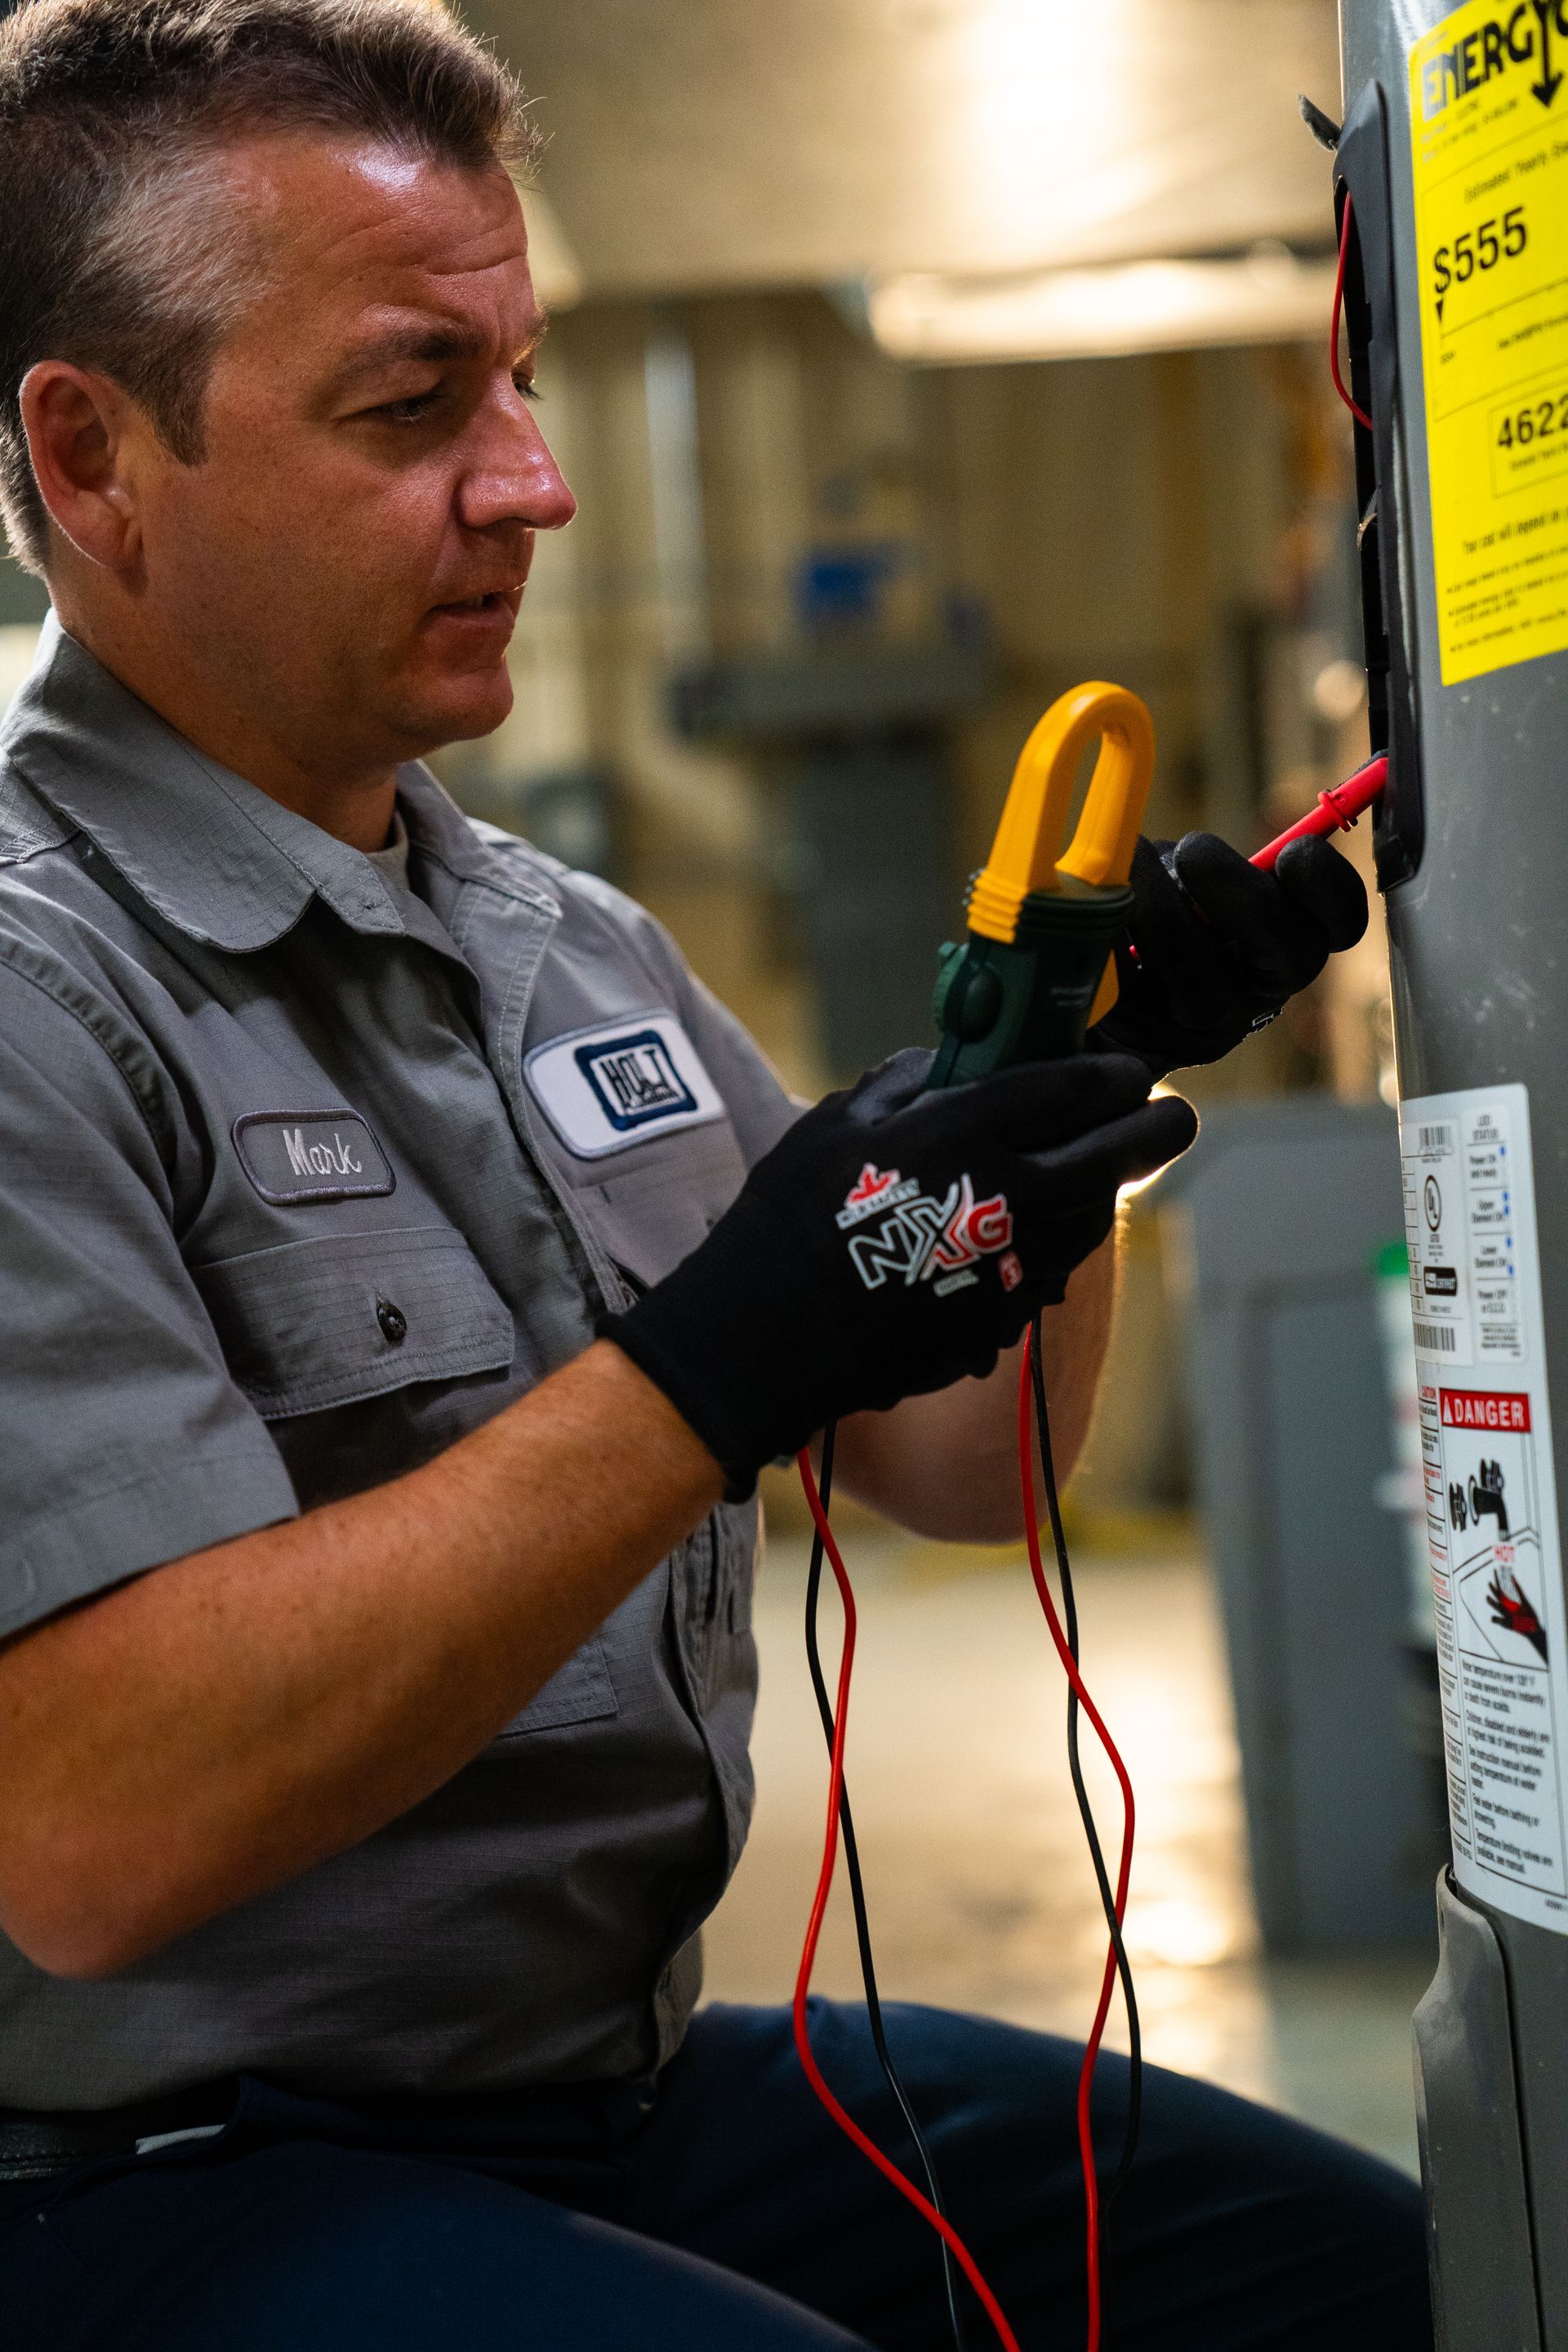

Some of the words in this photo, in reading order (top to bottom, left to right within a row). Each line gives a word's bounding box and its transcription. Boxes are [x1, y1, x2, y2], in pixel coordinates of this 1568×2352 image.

[1434, 207, 1526, 294] $555
[282, 1129, 362, 1176] Mark
[1454, 1397, 1525, 1428] DANGER
[1494, 1545, 1516, 1563] HOT
